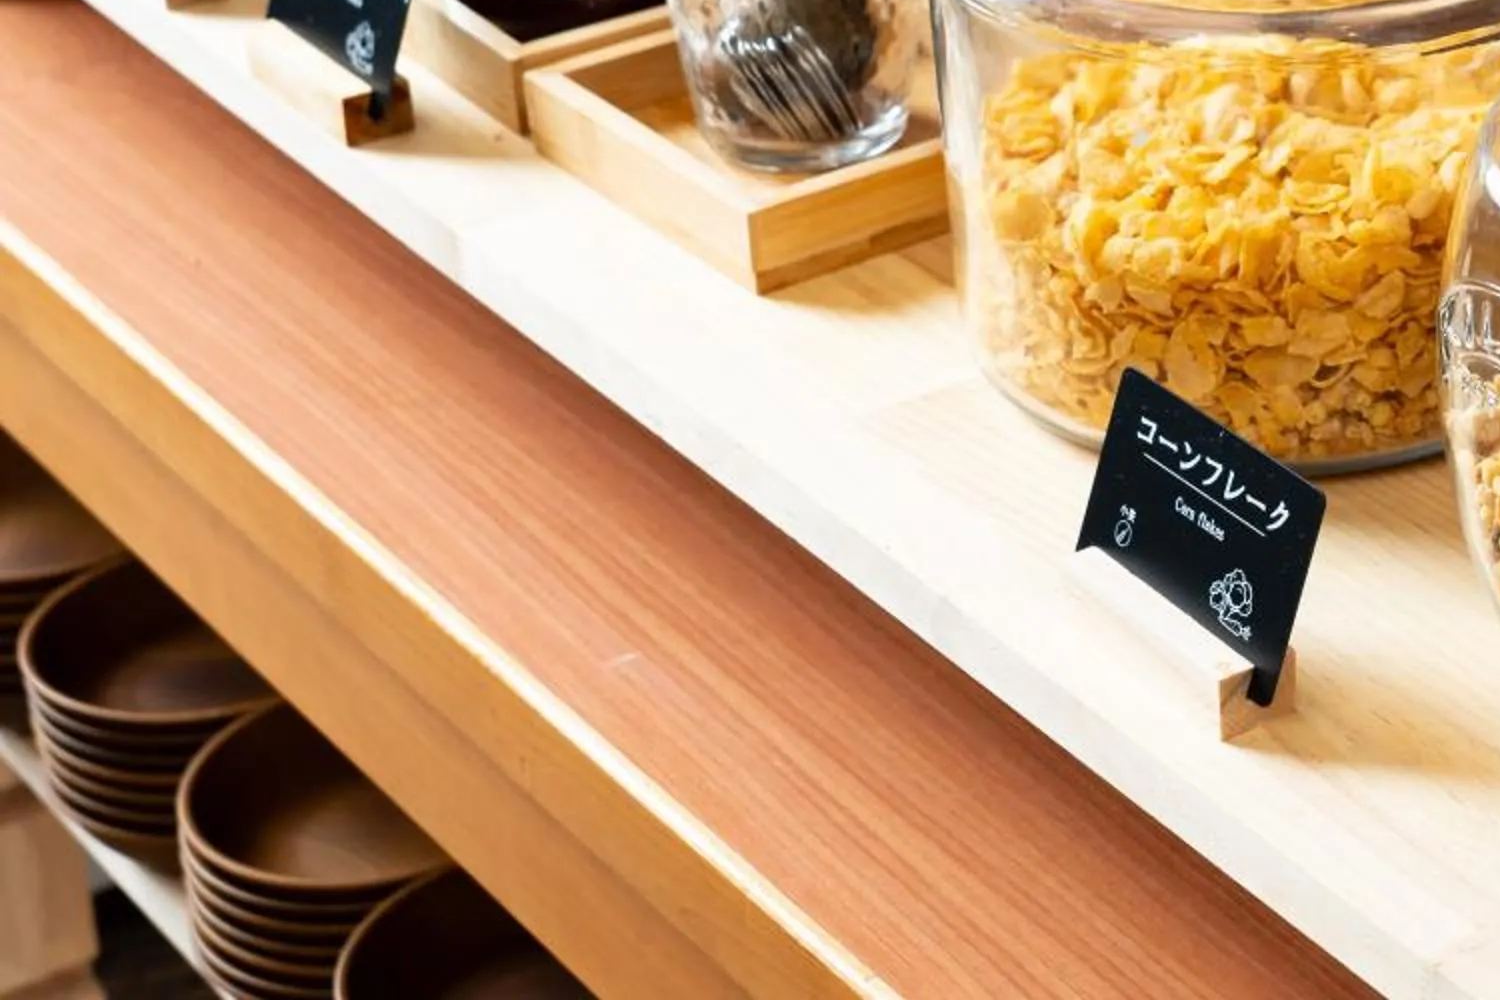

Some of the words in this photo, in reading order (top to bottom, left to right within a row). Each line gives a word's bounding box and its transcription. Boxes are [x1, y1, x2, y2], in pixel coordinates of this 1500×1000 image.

[1136, 416, 1291, 530] コーンフレーク
